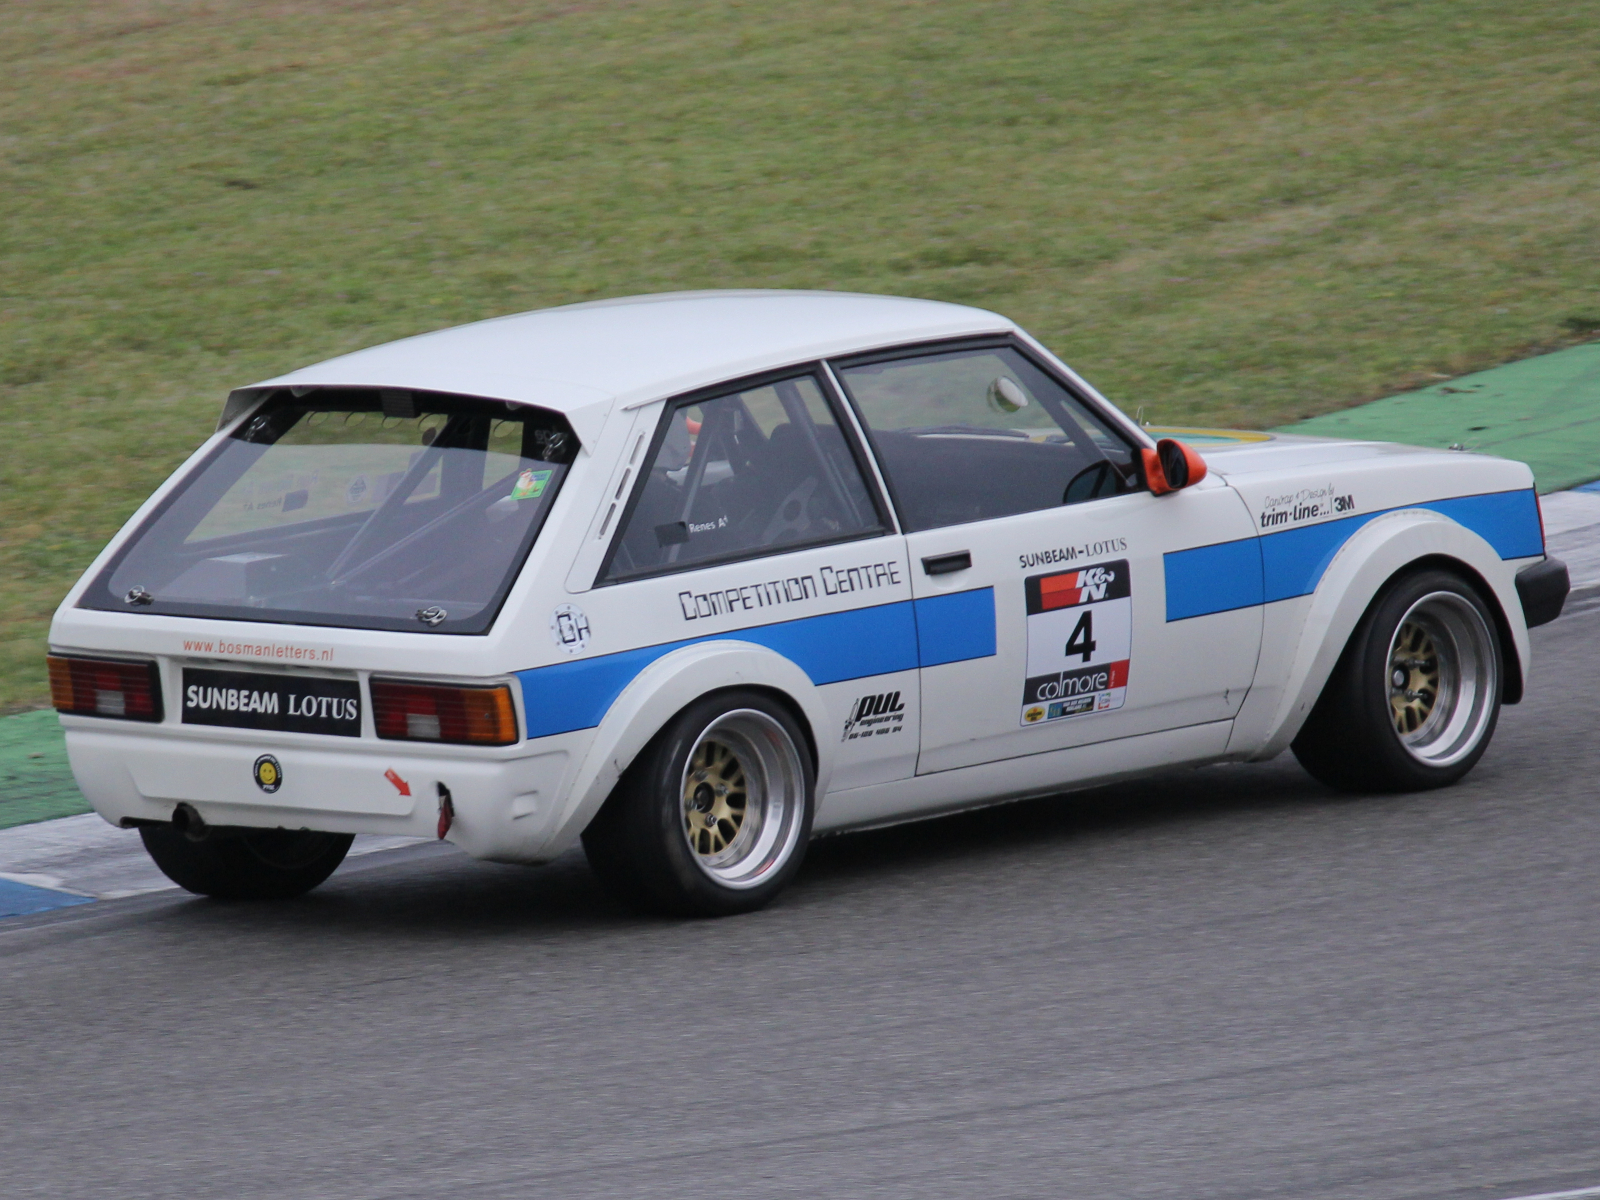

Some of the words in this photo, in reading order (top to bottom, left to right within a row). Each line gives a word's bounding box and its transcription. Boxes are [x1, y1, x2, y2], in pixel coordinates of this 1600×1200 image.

[1334, 494, 1355, 513] 3M
[1019, 537, 1128, 569] SUNBEAM-LOTUS
[183, 638, 335, 662] www.bosmanletters.nl
[1065, 609, 1097, 663] 4
[1036, 670, 1108, 702] colmore
[186, 684, 279, 715] SUNBEAM
[287, 693, 358, 722] LOTUS
